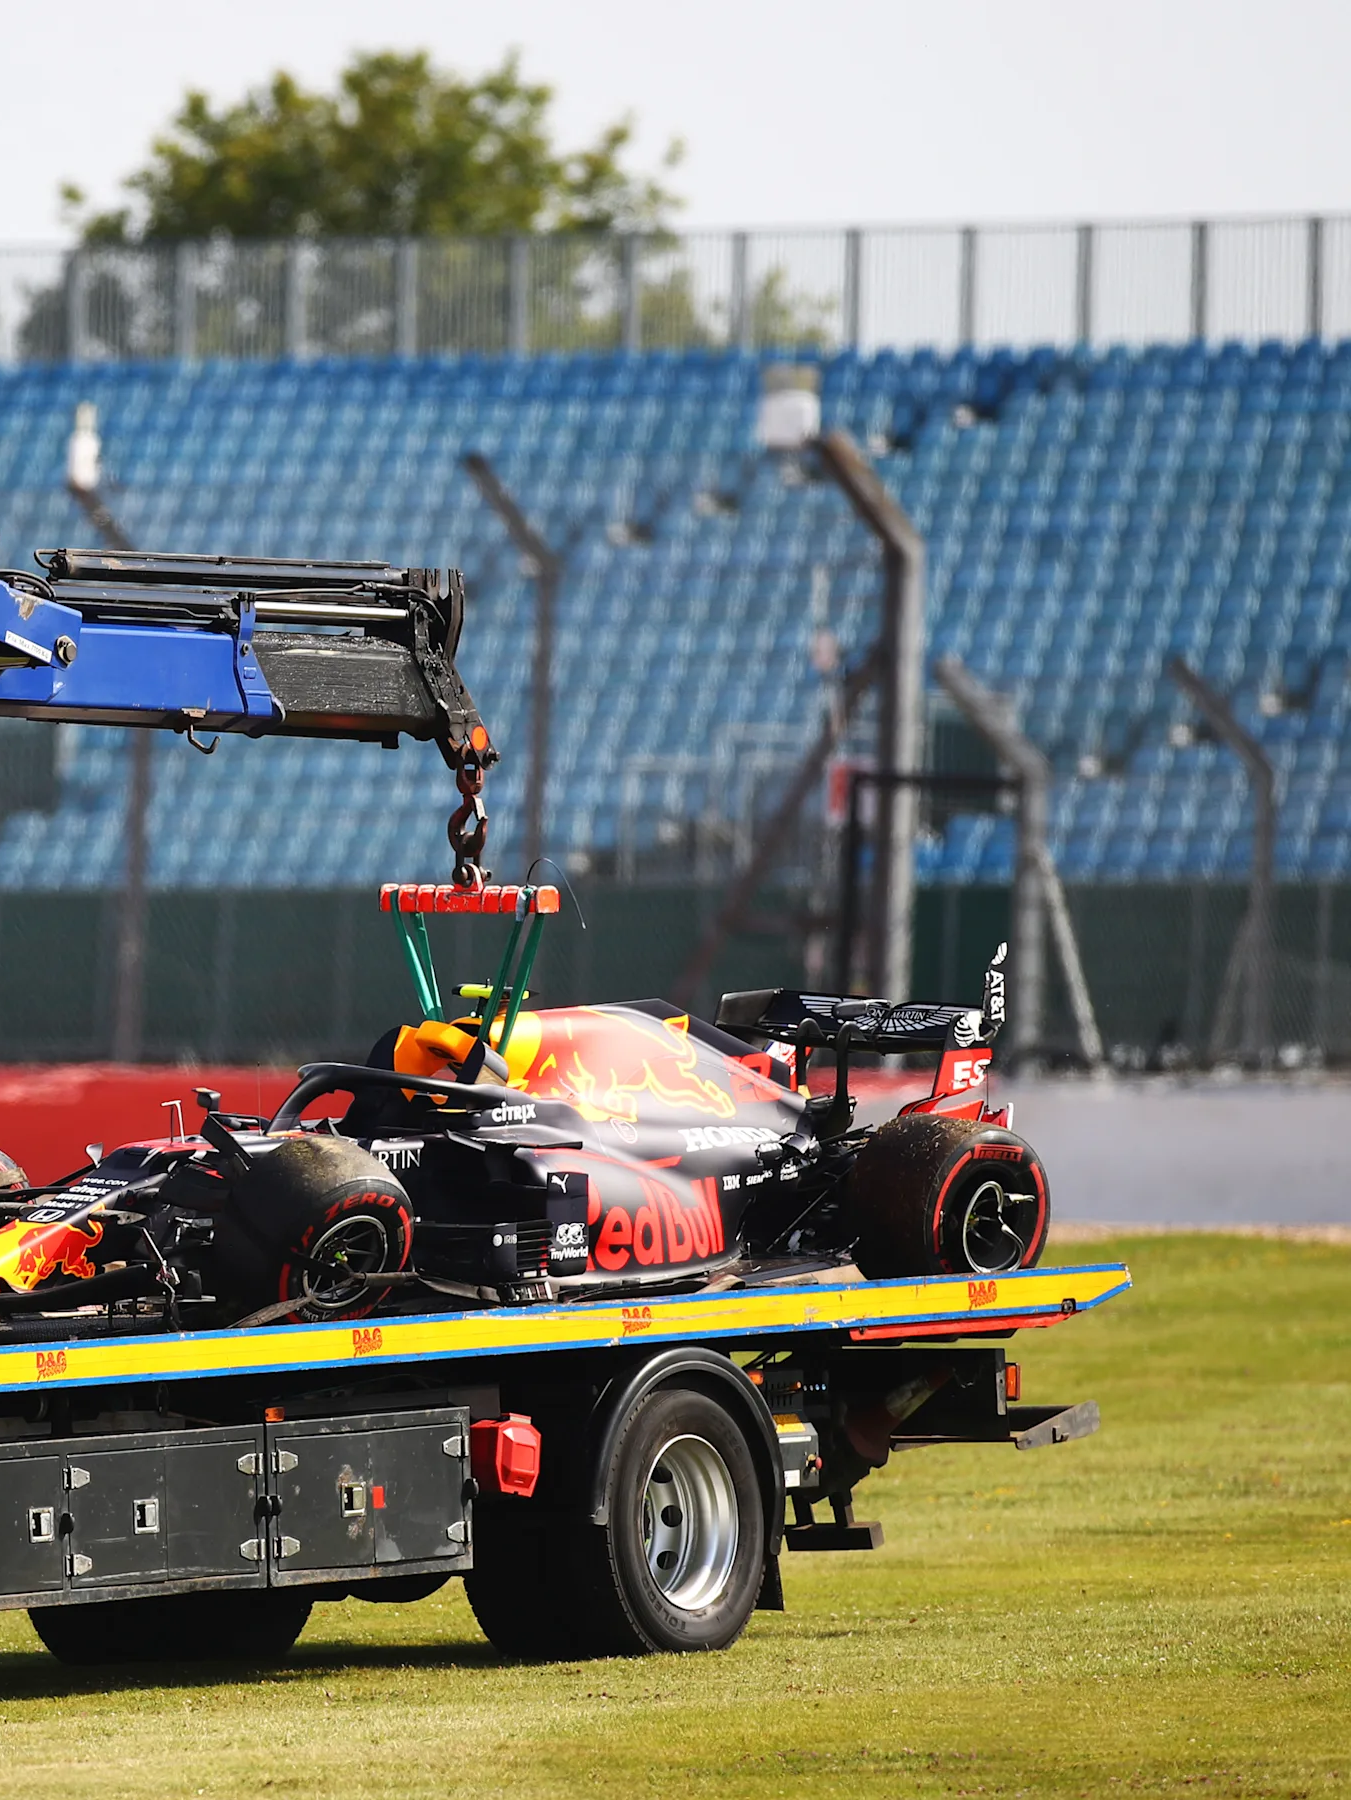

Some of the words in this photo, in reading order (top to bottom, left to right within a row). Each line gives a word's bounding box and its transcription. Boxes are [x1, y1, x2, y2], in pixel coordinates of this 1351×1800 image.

[989, 969, 1006, 1022] AT&T
[890, 1011, 926, 1021] MARTIN
[678, 1126, 781, 1152] HONDA
[378, 1149, 421, 1170] RTIN
[973, 1143, 1024, 1162] PIRELLI
[722, 1174, 741, 1191] IBM
[323, 1191, 397, 1224] ZERO
[550, 1245, 589, 1261] myWorld
[968, 1280, 997, 1298] D&G
[353, 1327, 382, 1346] D&G
[36, 1350, 66, 1368] D&G
